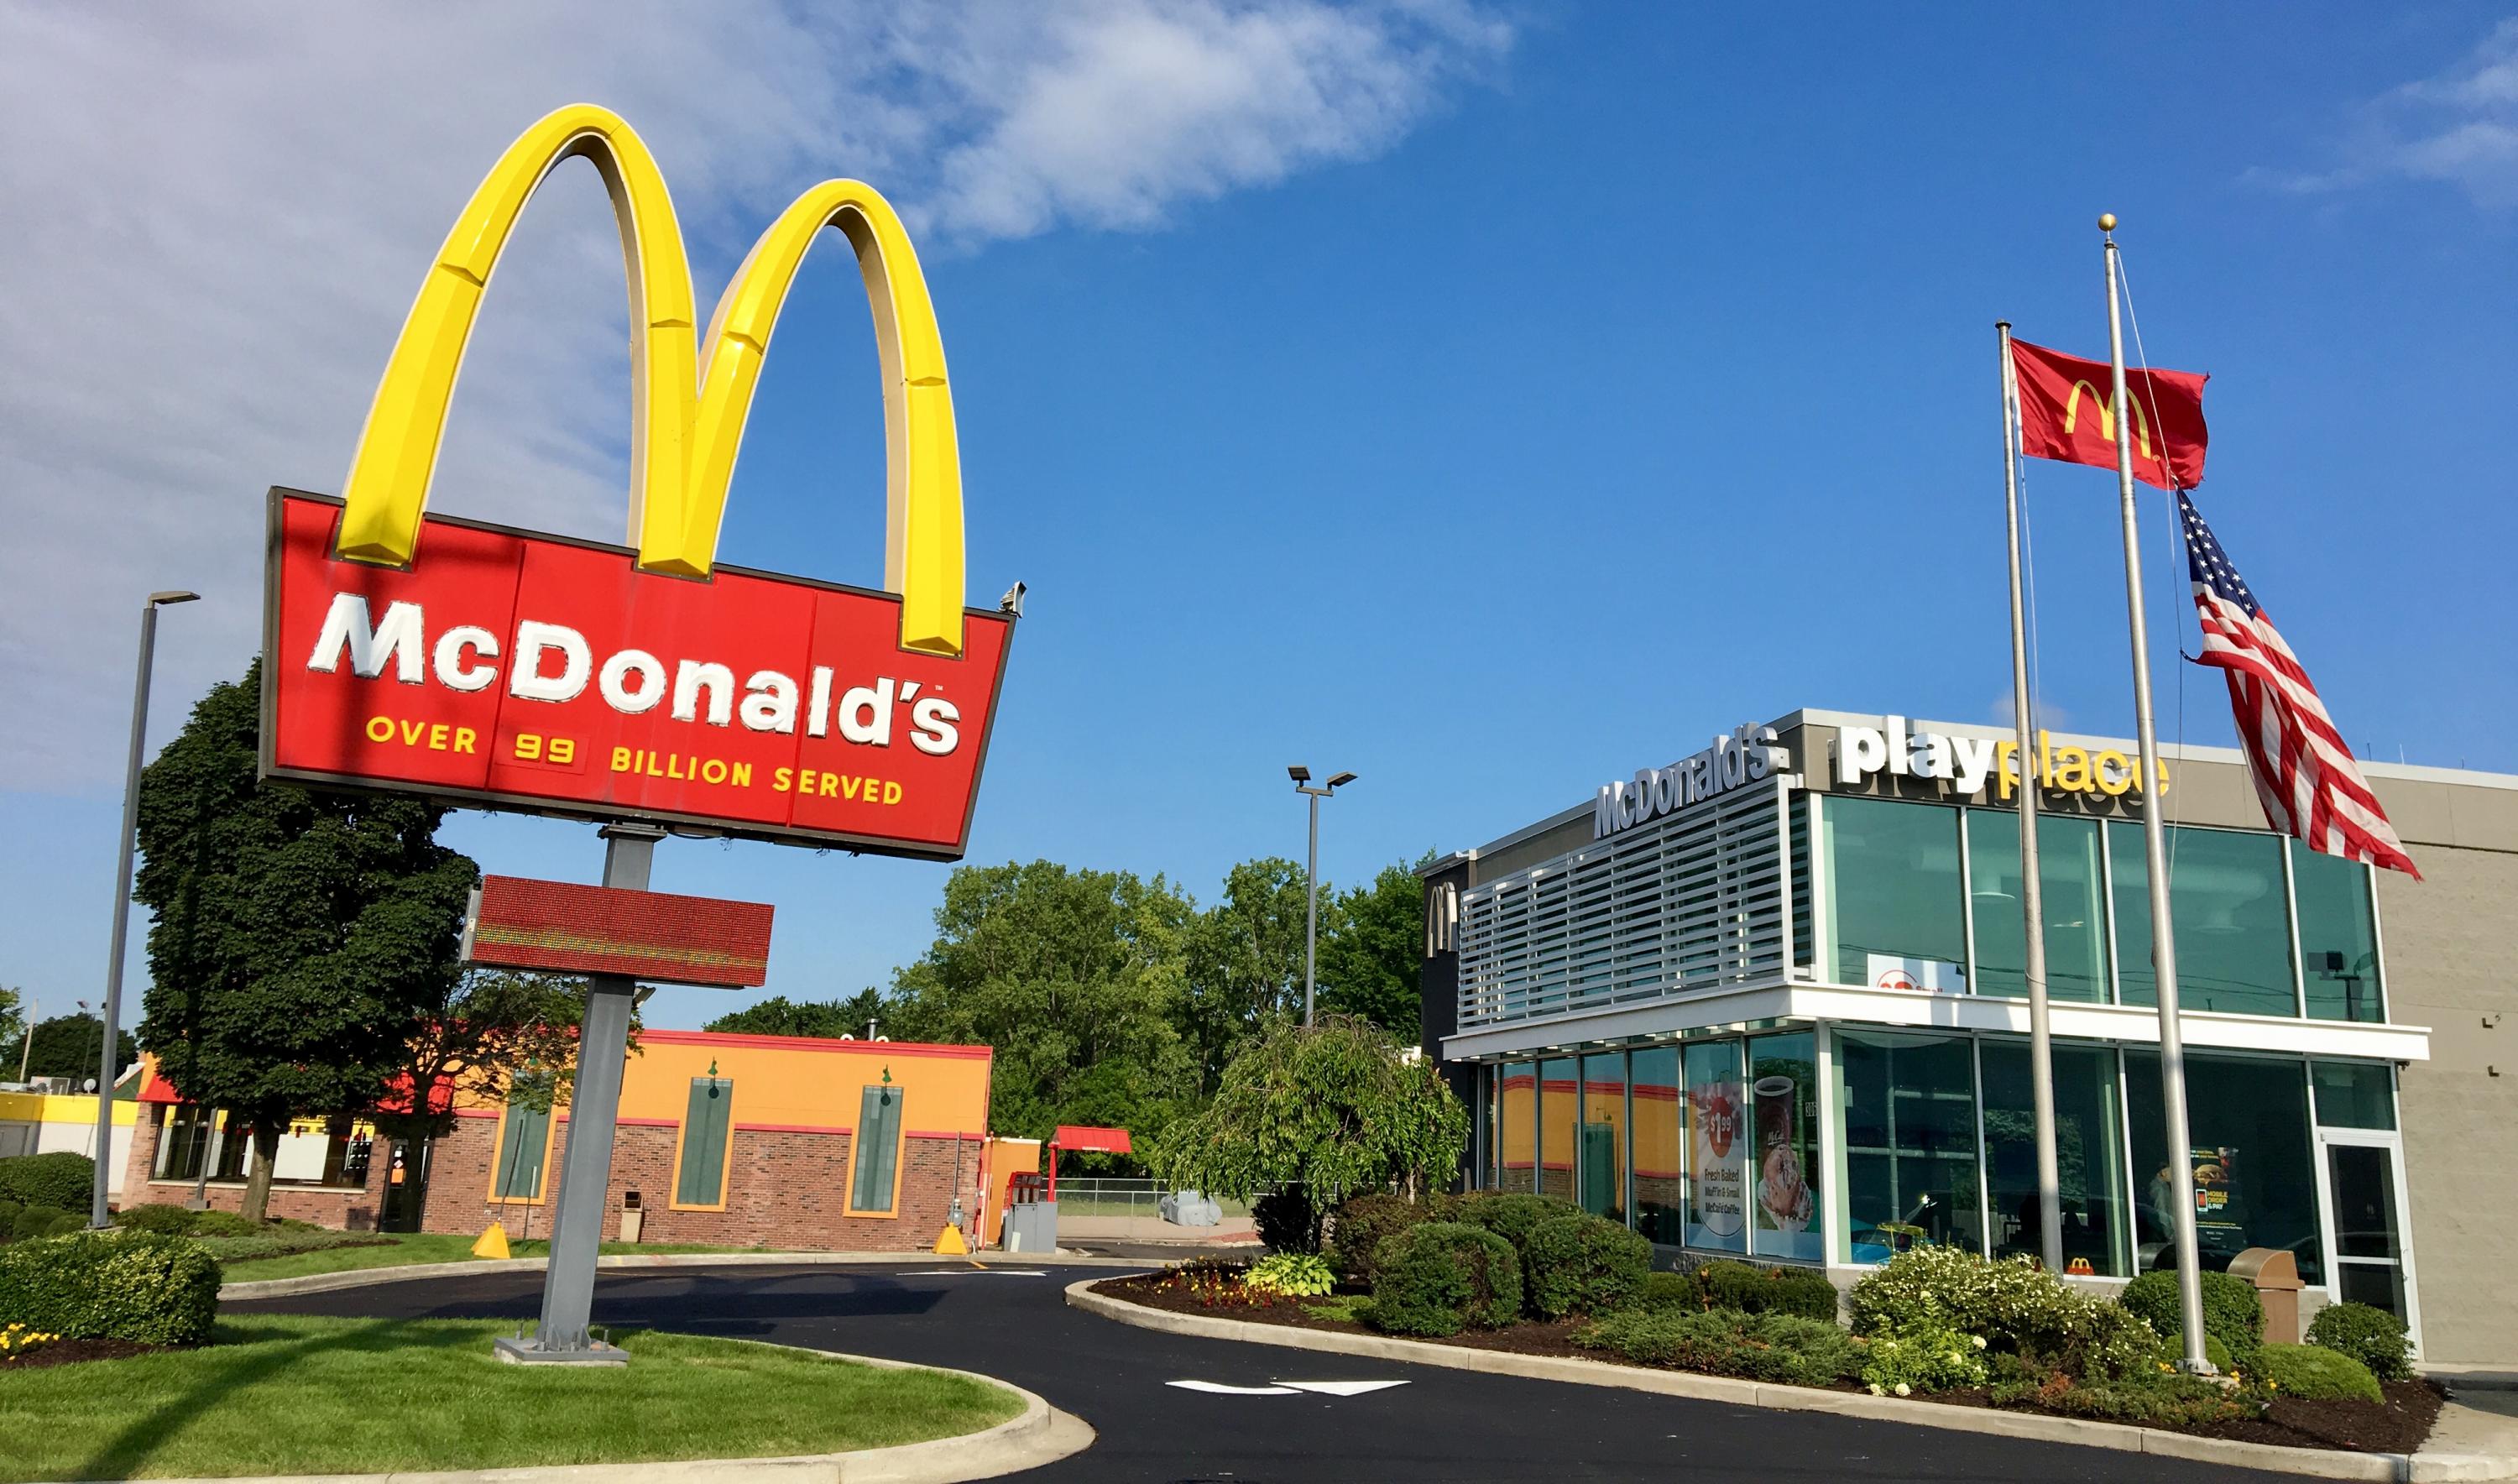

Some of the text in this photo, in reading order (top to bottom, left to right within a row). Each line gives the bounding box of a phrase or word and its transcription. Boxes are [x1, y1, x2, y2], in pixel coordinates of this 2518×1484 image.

[306, 591, 962, 756] McDonald's
[365, 715, 903, 806] OVER 99 BILLION SERVED
[1595, 721, 1779, 839] McDonald's
[1705, 1168, 1739, 1183] Fresh Baked
